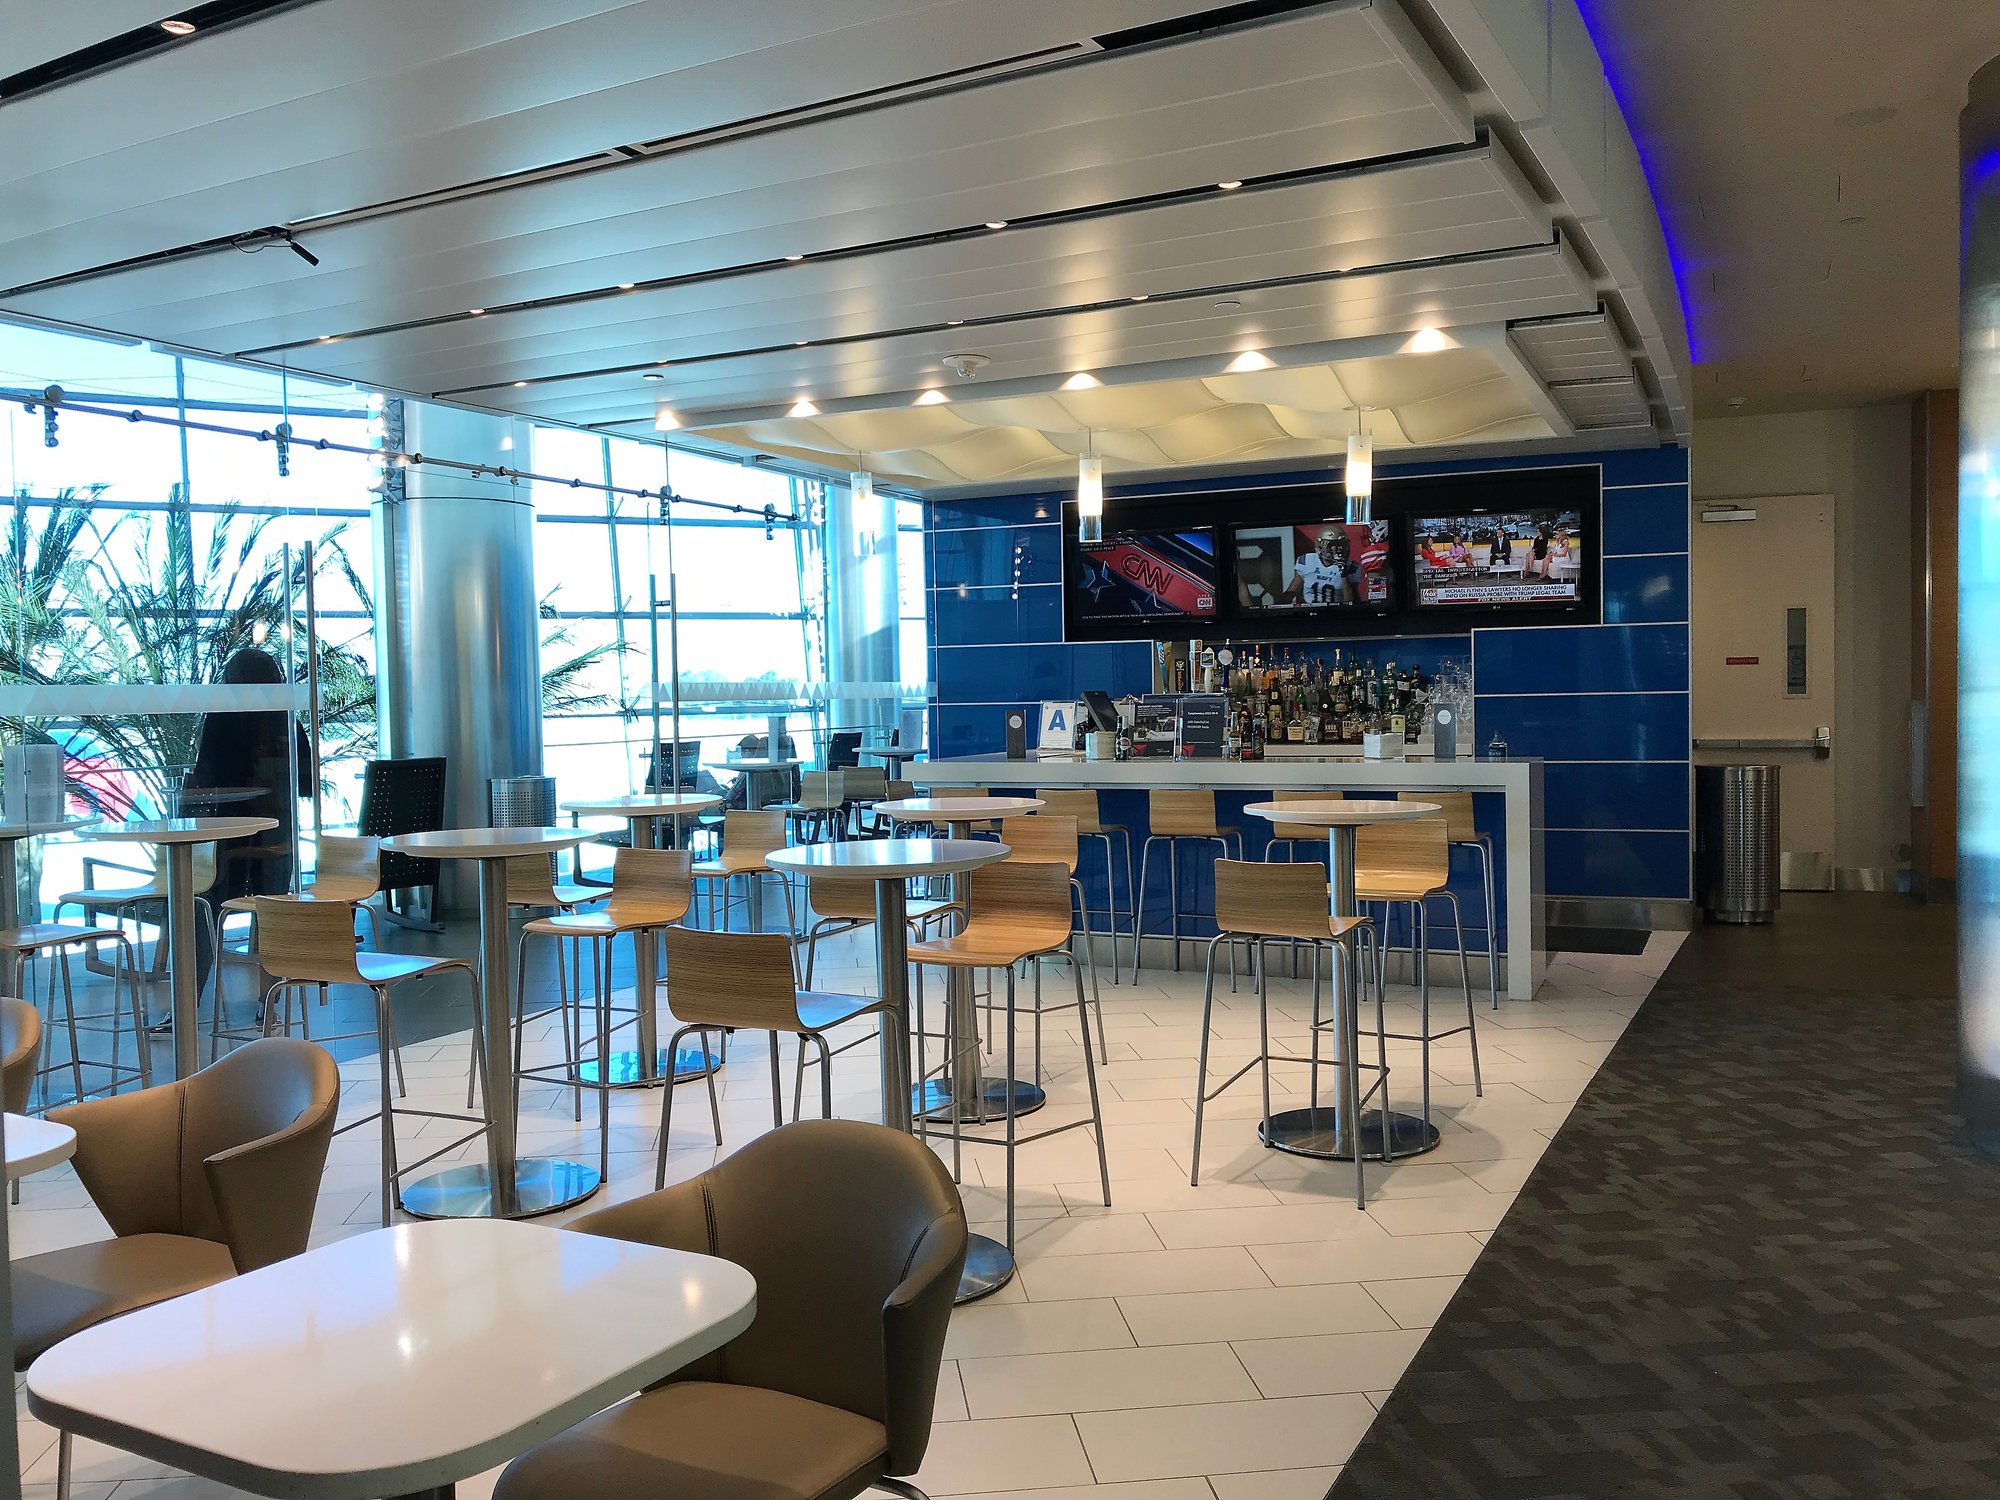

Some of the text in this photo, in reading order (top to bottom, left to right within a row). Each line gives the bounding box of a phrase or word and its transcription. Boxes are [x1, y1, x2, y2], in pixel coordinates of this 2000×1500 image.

[1120, 554, 1173, 596] CNN
[1311, 582, 1336, 603] 10
[1048, 710, 1066, 730] A
